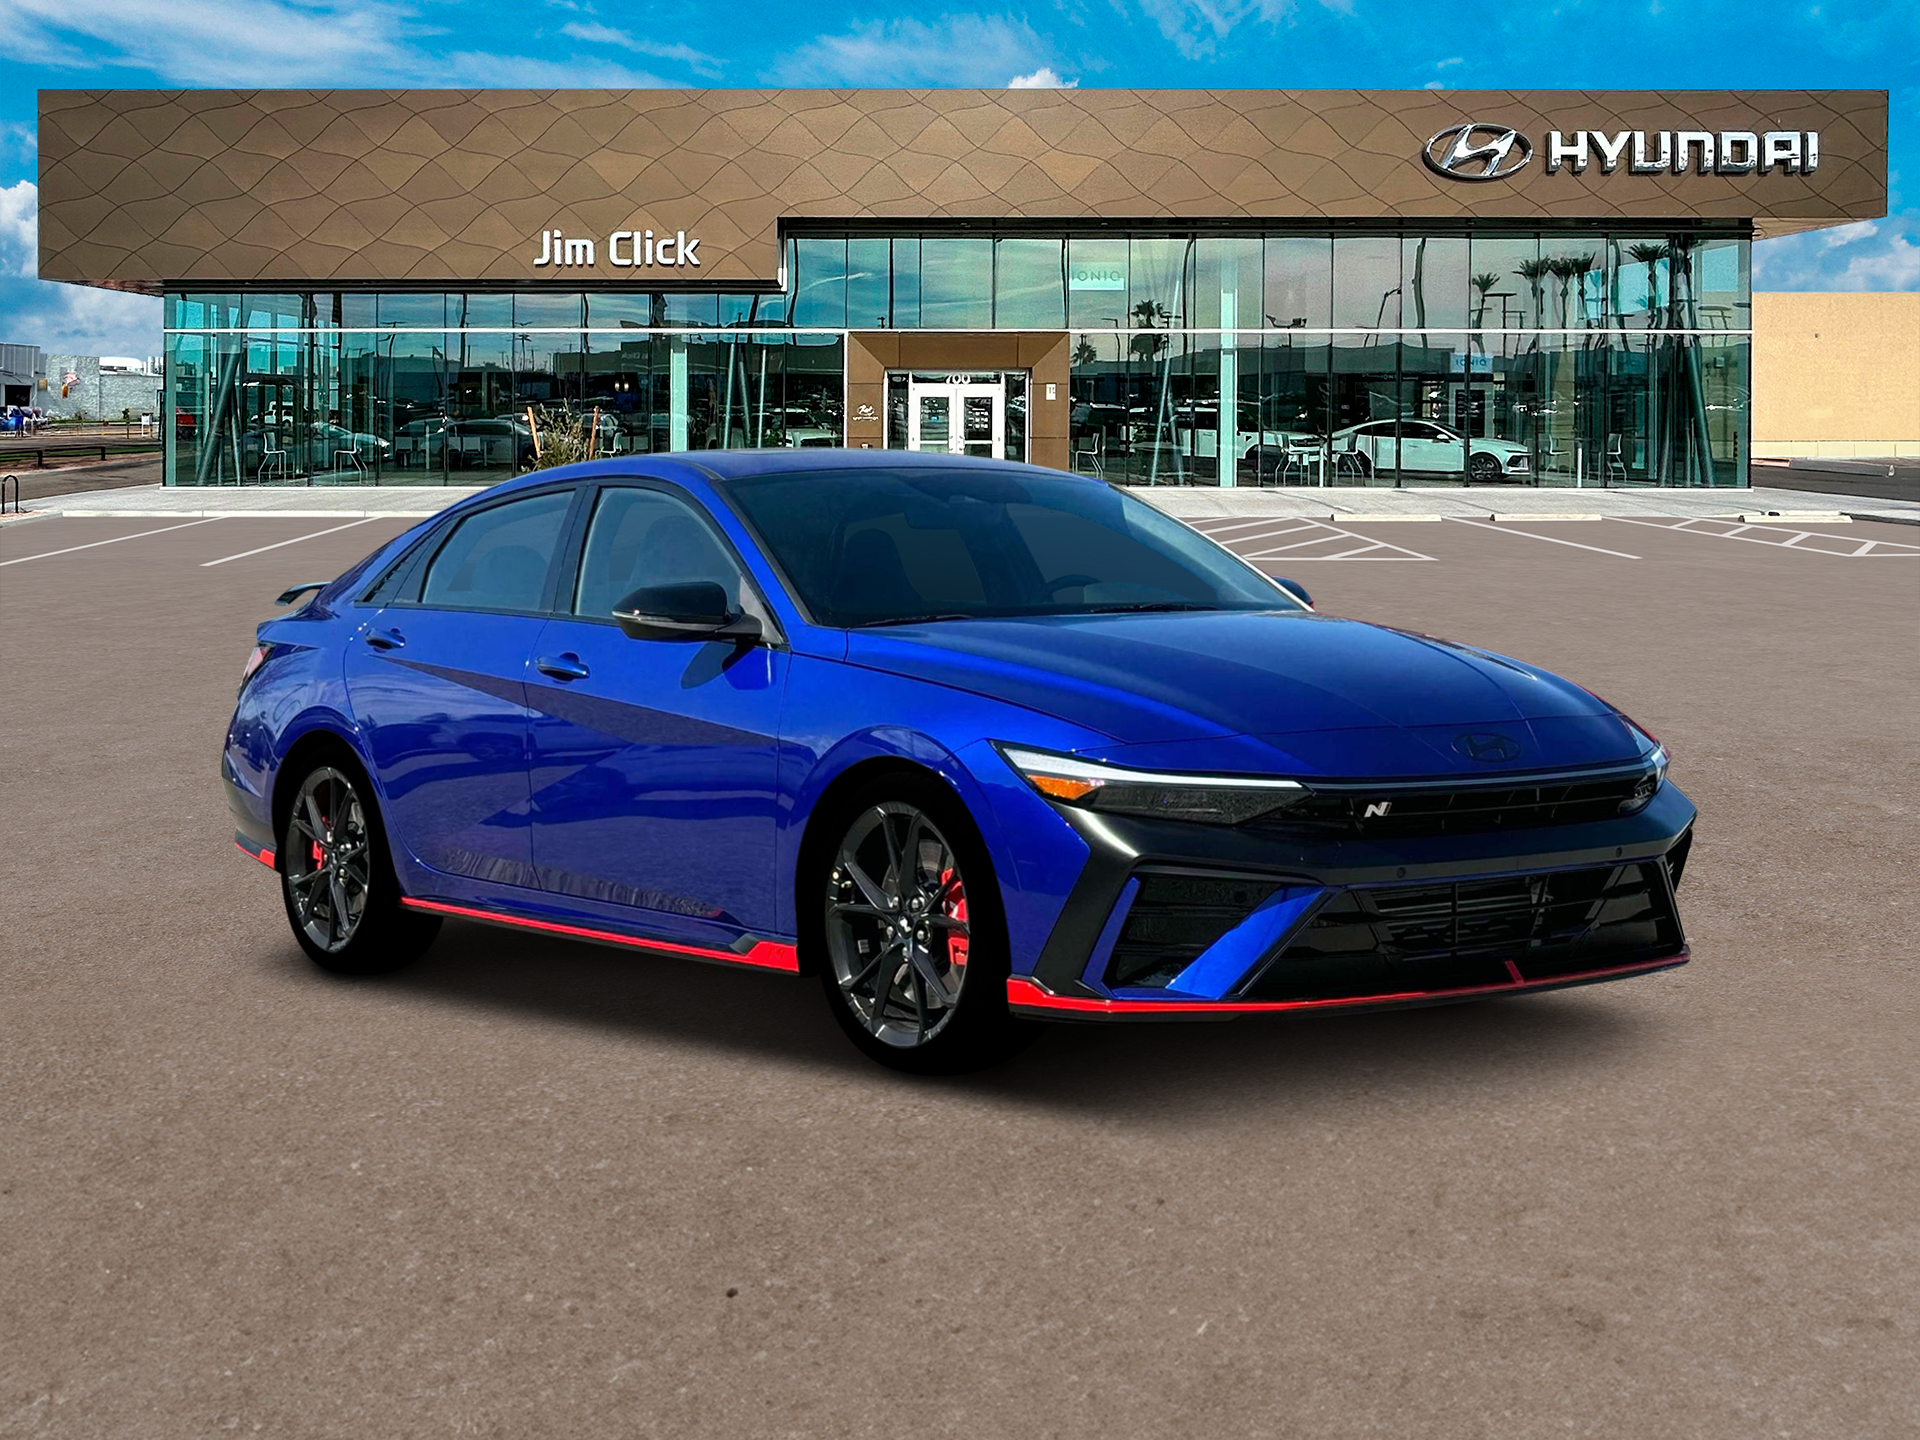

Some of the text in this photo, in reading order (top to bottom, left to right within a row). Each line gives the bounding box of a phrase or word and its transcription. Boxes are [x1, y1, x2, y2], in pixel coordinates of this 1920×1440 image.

[1546, 130, 1819, 174] HYUNDAI
[533, 229, 701, 266] Jim Click
